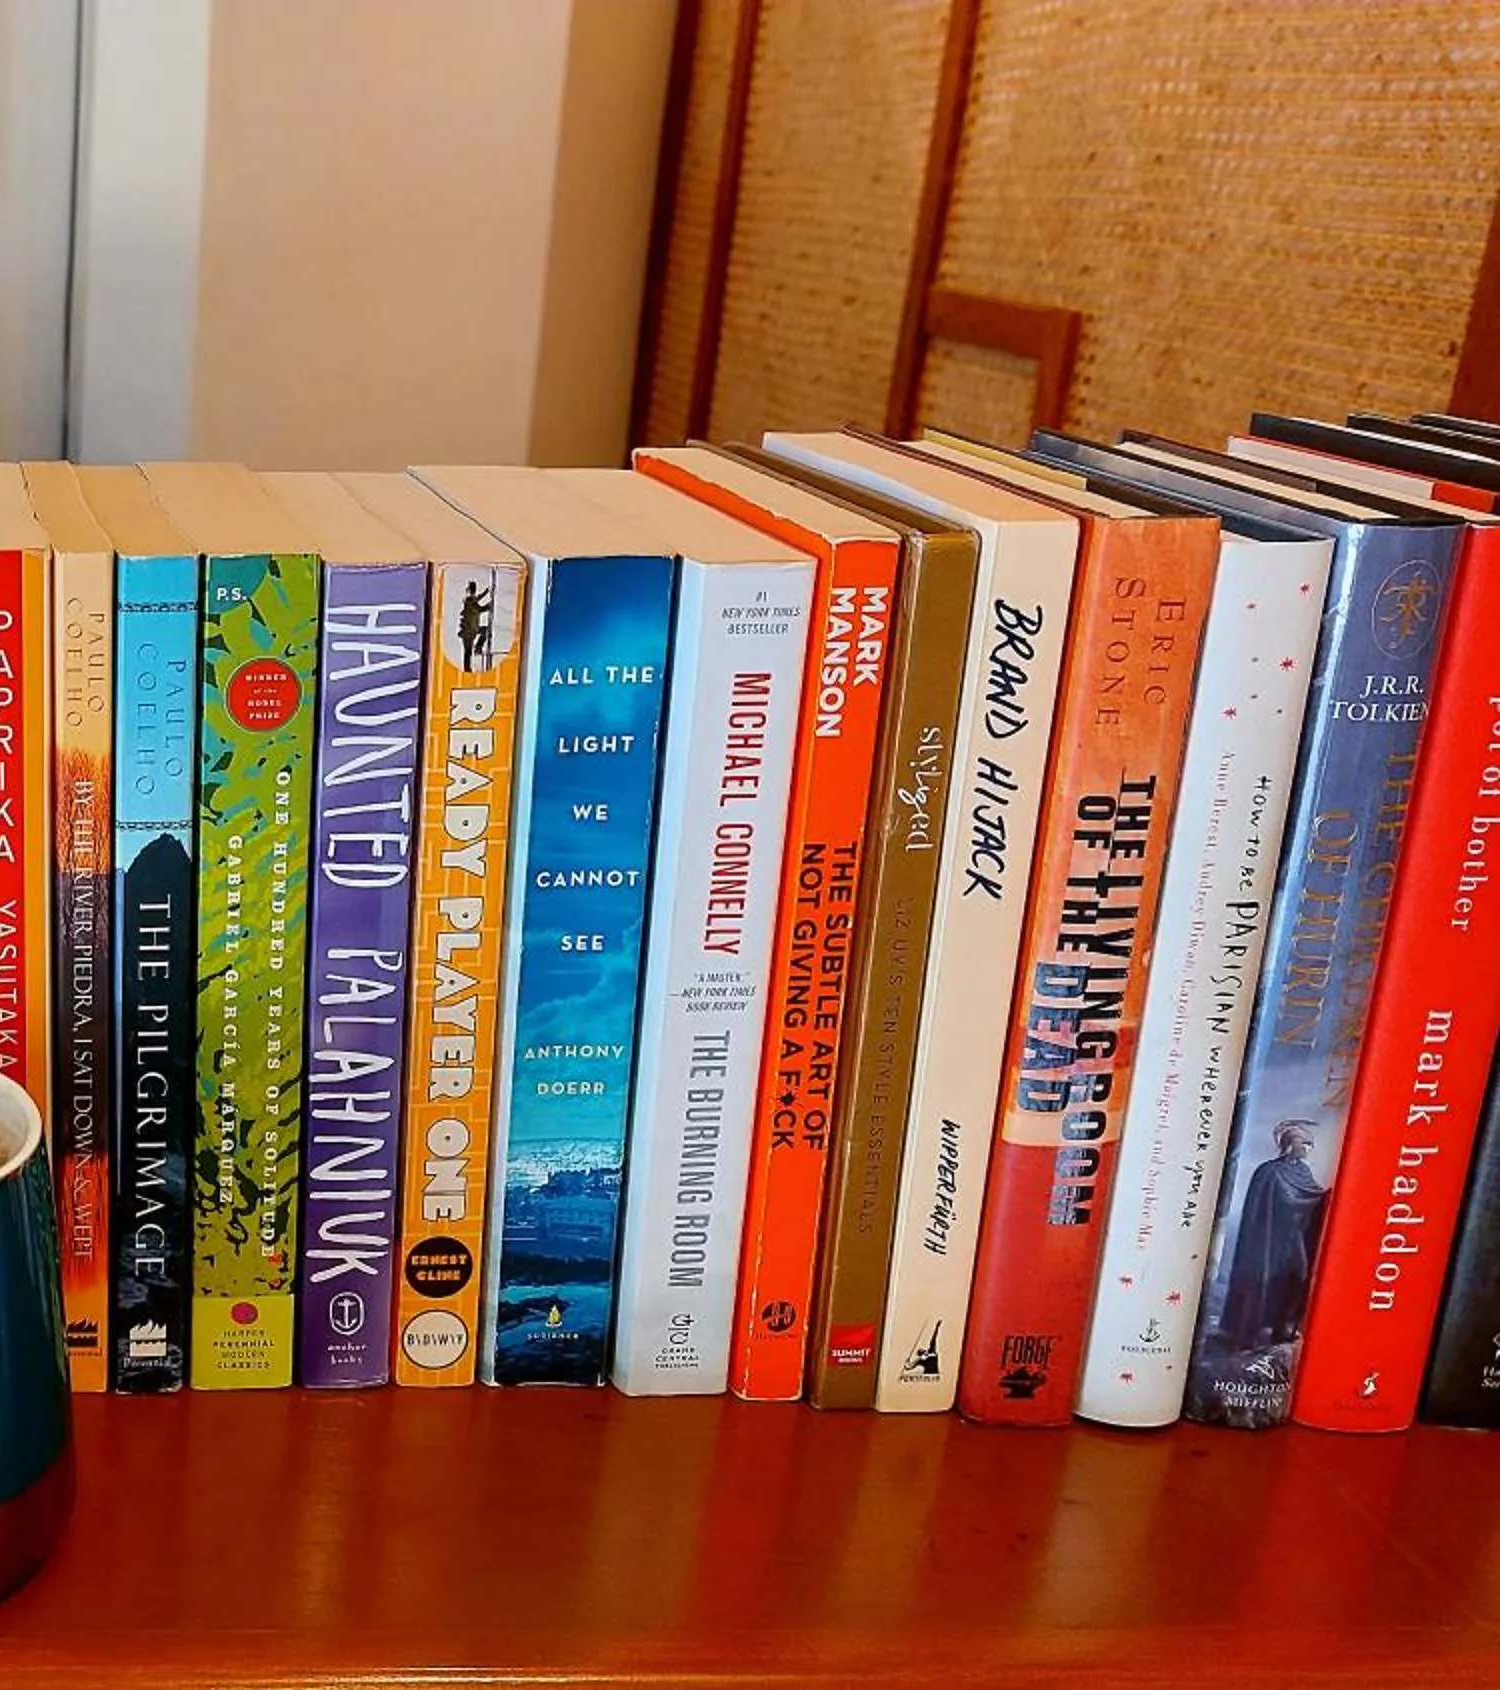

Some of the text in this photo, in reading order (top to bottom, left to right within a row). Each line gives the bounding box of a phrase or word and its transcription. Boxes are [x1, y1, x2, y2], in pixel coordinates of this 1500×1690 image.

[216, 586, 248, 602] P.S.
[727, 623, 789, 635] BESTSELLER
[853, 586, 889, 687] MARK
[65, 597, 83, 728] COELHO
[87, 612, 105, 714] PAULO
[549, 666, 654, 686] ALL THE
[815, 586, 858, 738] MANSON
[1095, 576, 1147, 726] STONE
[1143, 599, 1185, 706] ERIC
[1360, 675, 1424, 699] J.R.R.
[135, 642, 157, 796] COELHO
[164, 658, 187, 779] PAULO
[557, 735, 635, 754] LIGHT
[719, 672, 772, 808] MICHAEL
[962, 598, 1043, 900] BRAND HIJACK
[1329, 699, 1428, 722] TOLKIEN
[572, 804, 609, 822] WE
[1308, 809, 1358, 877] OF
[73, 867, 94, 939] RIVER
[224, 834, 243, 954] GABRIEL
[536, 870, 641, 888] CANNOT
[703, 823, 753, 955] CONNELLY
[797, 843, 827, 909] NOT
[1451, 815, 1500, 931] bother
[73, 944, 93, 1032] PIEDRA,
[305, 603, 420, 1283] HAUNTED PALAHNIUK
[422, 687, 497, 1223] READY PLAYER ONE
[560, 934, 605, 952] SEE
[783, 919, 817, 1029] GIVING
[1017, 794, 1117, 1113] OF THE DEAD
[1206, 901, 1261, 1035] PARISIAN
[222, 968, 241, 1067] GARCÍA
[260, 771, 293, 1257] ONE HUNDRED YEARS OF SOLITUDE
[802, 840, 858, 1151] THE SUBTLE ART OF
[1046, 774, 1157, 1226] THE LIVING ROOM
[73, 1050, 93, 1089] SAT
[135, 893, 171, 1278] THE PILGRIMAGE
[524, 1044, 625, 1059] ANTHONY
[536, 1081, 605, 1096] DOERR
[689, 1030, 731, 1079] THE
[780, 1038, 805, 1059] A
[73, 1094, 94, 1168] DOWN
[676, 1088, 724, 1205] BURNING
[1369, 1008, 1454, 1311] mark haddon
[73, 1203, 94, 1263] WEPT
[411, 1254, 467, 1266] ERNEST
[415, 1269, 461, 1281] CLINE
[667, 1213, 712, 1288] ROOM
[1001, 1333, 1056, 1369] FORGE
[1213, 1379, 1291, 1395] HOUGHTON
